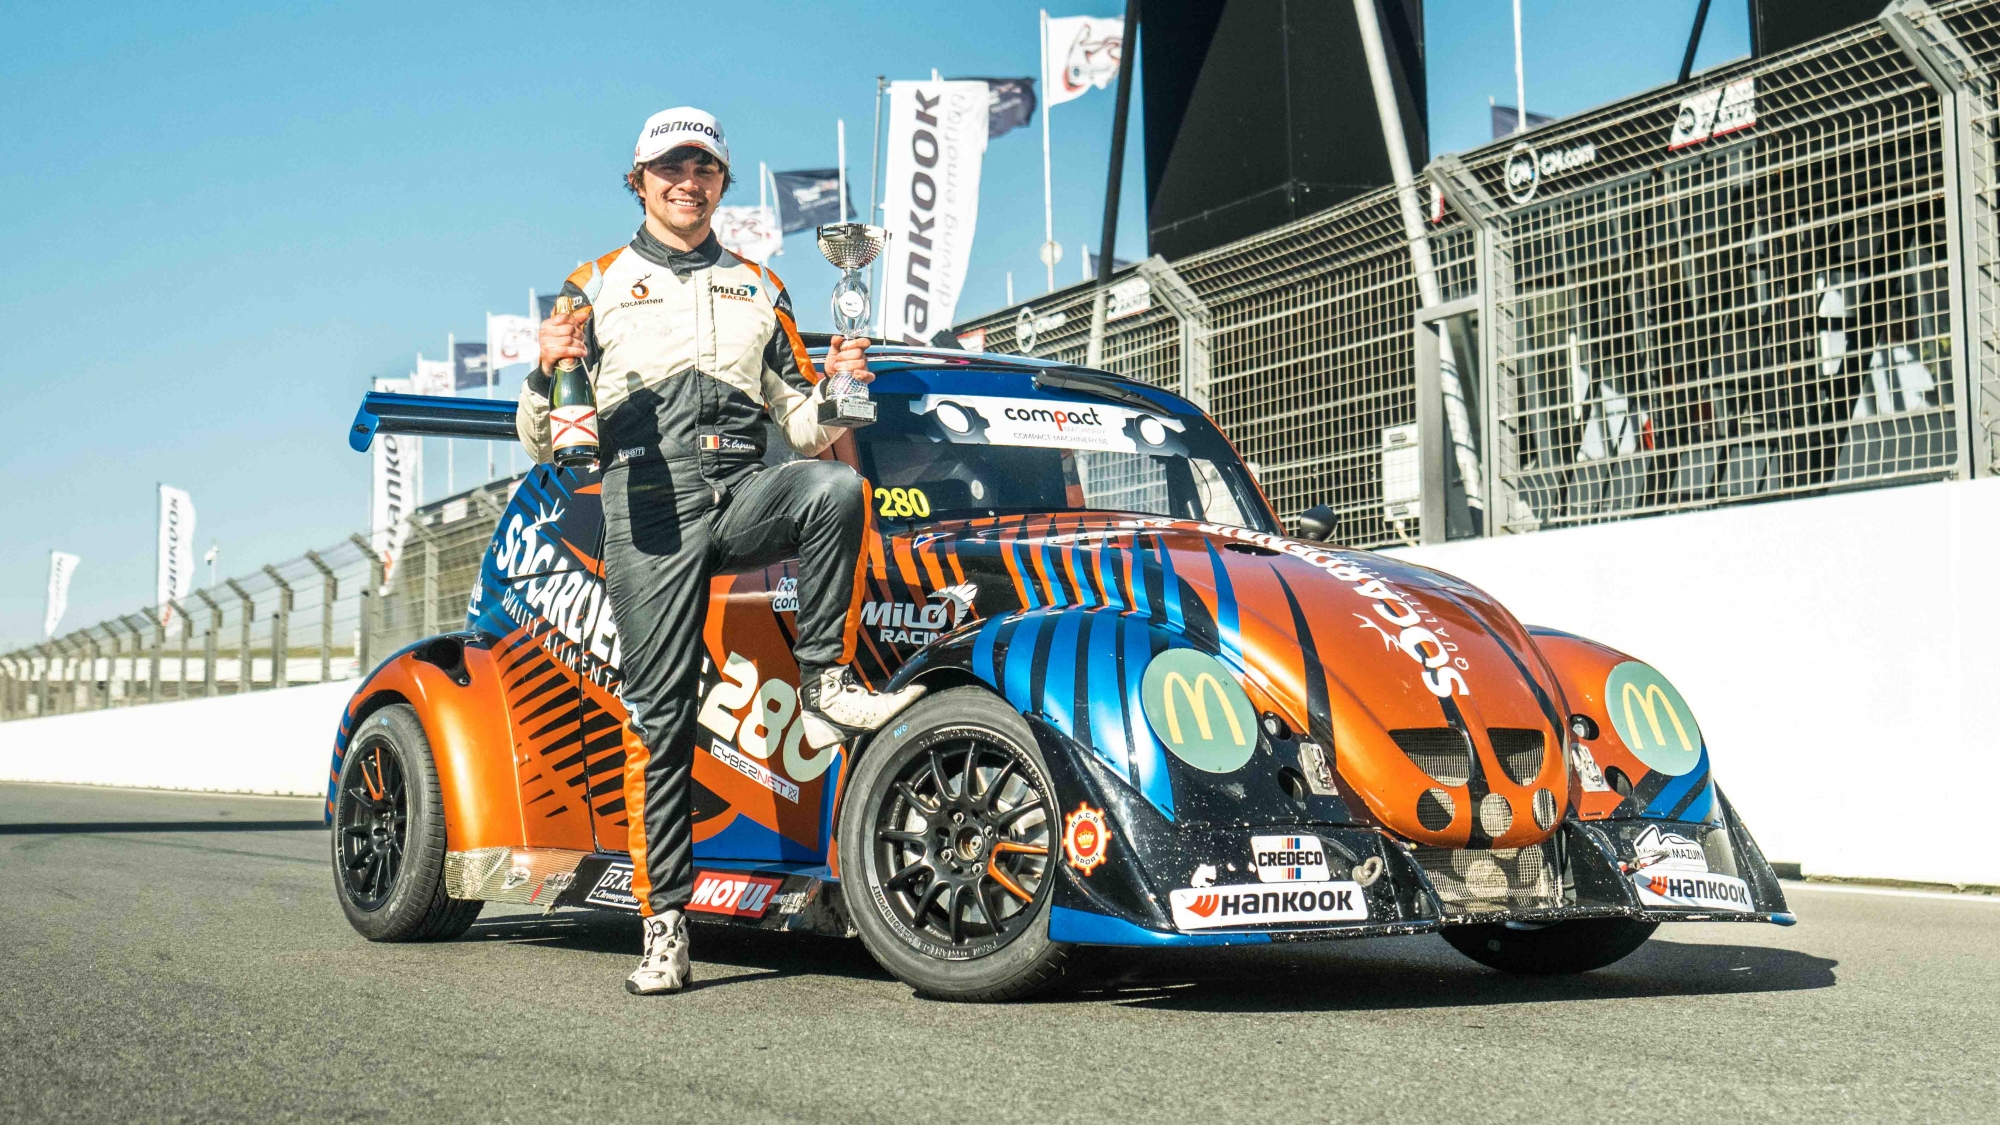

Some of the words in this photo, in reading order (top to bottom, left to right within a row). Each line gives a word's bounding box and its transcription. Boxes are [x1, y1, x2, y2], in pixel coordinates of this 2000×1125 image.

[620, 298, 664, 308] SOCARDENNE
[720, 294, 754, 303] RACING
[1004, 407, 1102, 431] compact
[874, 487, 930, 518] 280
[496, 513, 622, 670] SOCARDE
[1396, 590, 1470, 671] QUALITY
[501, 587, 540, 639] QUALITY
[543, 635, 623, 703] ALIMENTA
[1074, 851, 1100, 865] SPORT
[1258, 850, 1323, 867] CREDECO
[1672, 848, 1705, 860] MAZUIN
[694, 878, 773, 912] MOTUL
